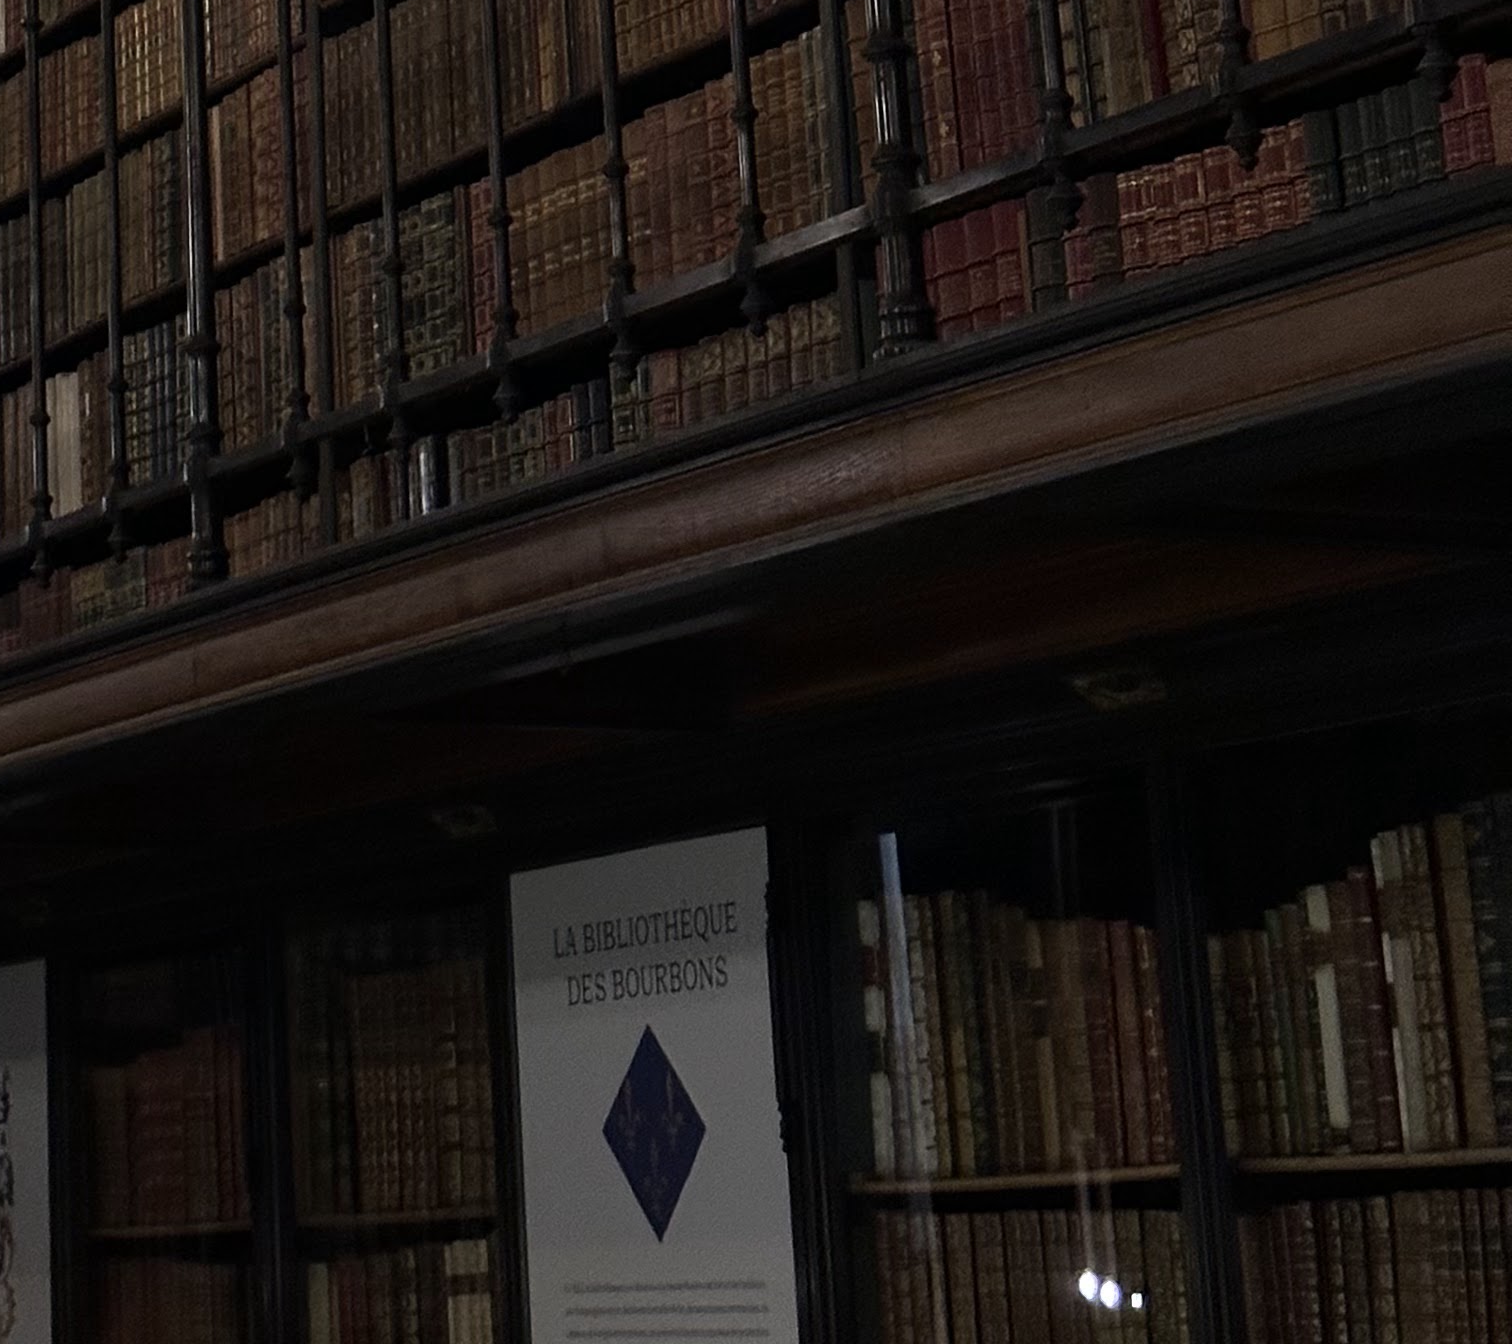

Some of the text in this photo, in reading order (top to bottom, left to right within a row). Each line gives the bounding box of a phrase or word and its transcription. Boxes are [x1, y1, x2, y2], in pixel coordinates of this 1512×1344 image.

[553, 899, 738, 958] LA BIBLIOTHÈQUE
[567, 955, 728, 1006] DES BOURBONS
